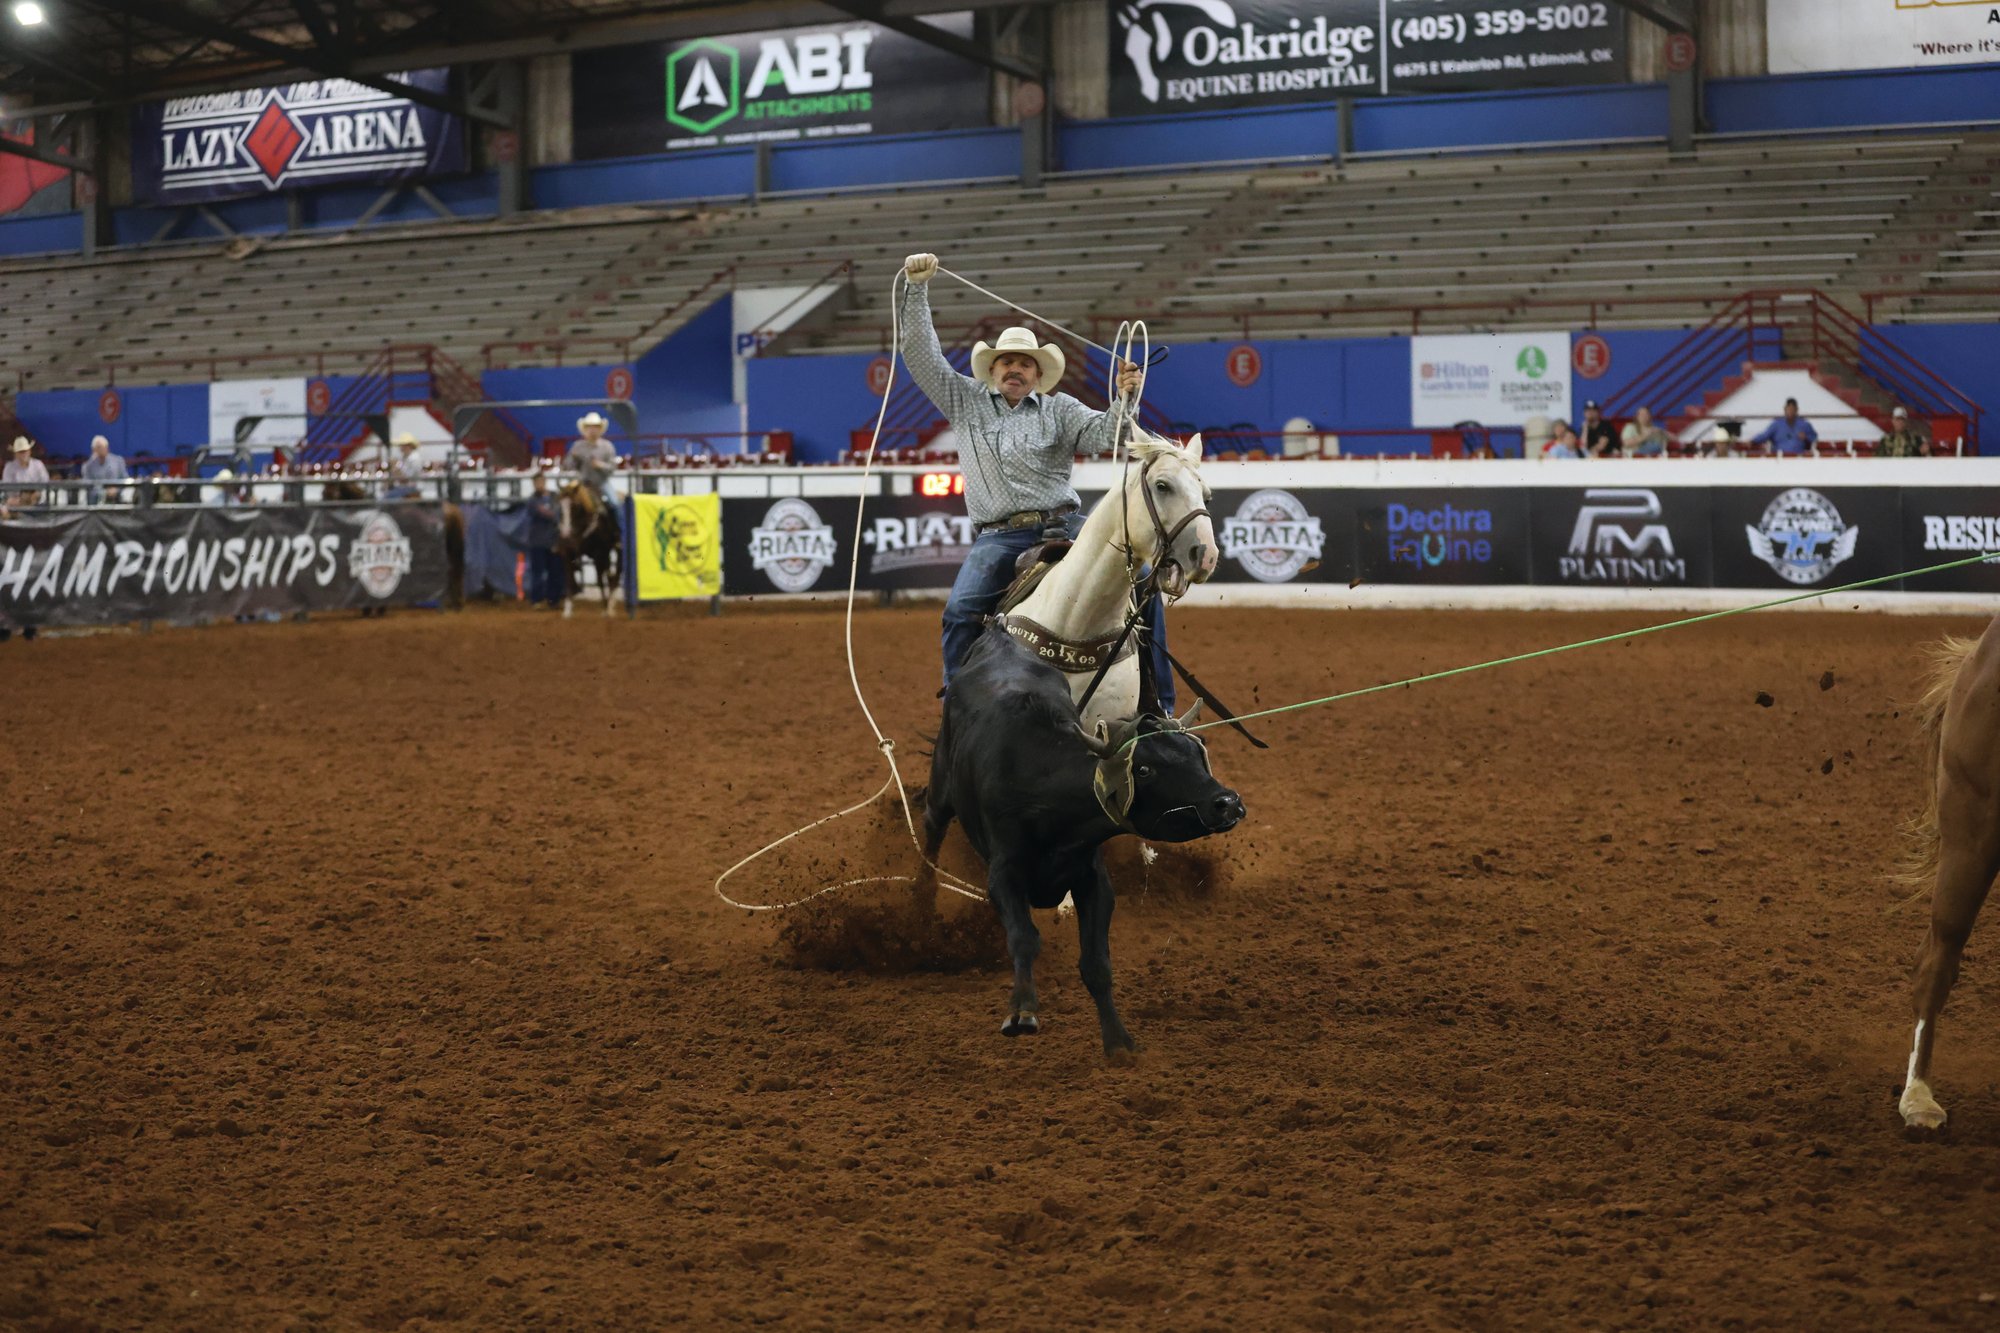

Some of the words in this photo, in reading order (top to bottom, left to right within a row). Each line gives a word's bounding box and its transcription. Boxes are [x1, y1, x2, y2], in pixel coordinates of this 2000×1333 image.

[1391, 13, 1467, 49] (405)
[1474, 3, 1609, 37] 359-5002
[1183, 16, 1375, 67] Oakridge
[744, 30, 873, 98] ABI
[1429, 60, 1440, 76] E
[1166, 73, 1254, 103] EQUINE
[1258, 64, 1375, 93] HOSPITAL
[743, 92, 873, 120] ATTACHMENTS
[162, 126, 243, 170] LAZY
[307, 108, 426, 157] ARENA
[1236, 353, 1250, 373] E
[1583, 343, 1599, 365] E
[1387, 503, 1492, 533] Dechra
[760, 534, 827, 558] RIATA
[875, 516, 974, 553] RIAT
[1232, 527, 1313, 547] RIATA
[1558, 557, 1686, 580] PLATINUM
[1006, 624, 1040, 645] SOUTH
[1039, 647, 1055, 658] 20
[1079, 655, 1096, 664] 09
